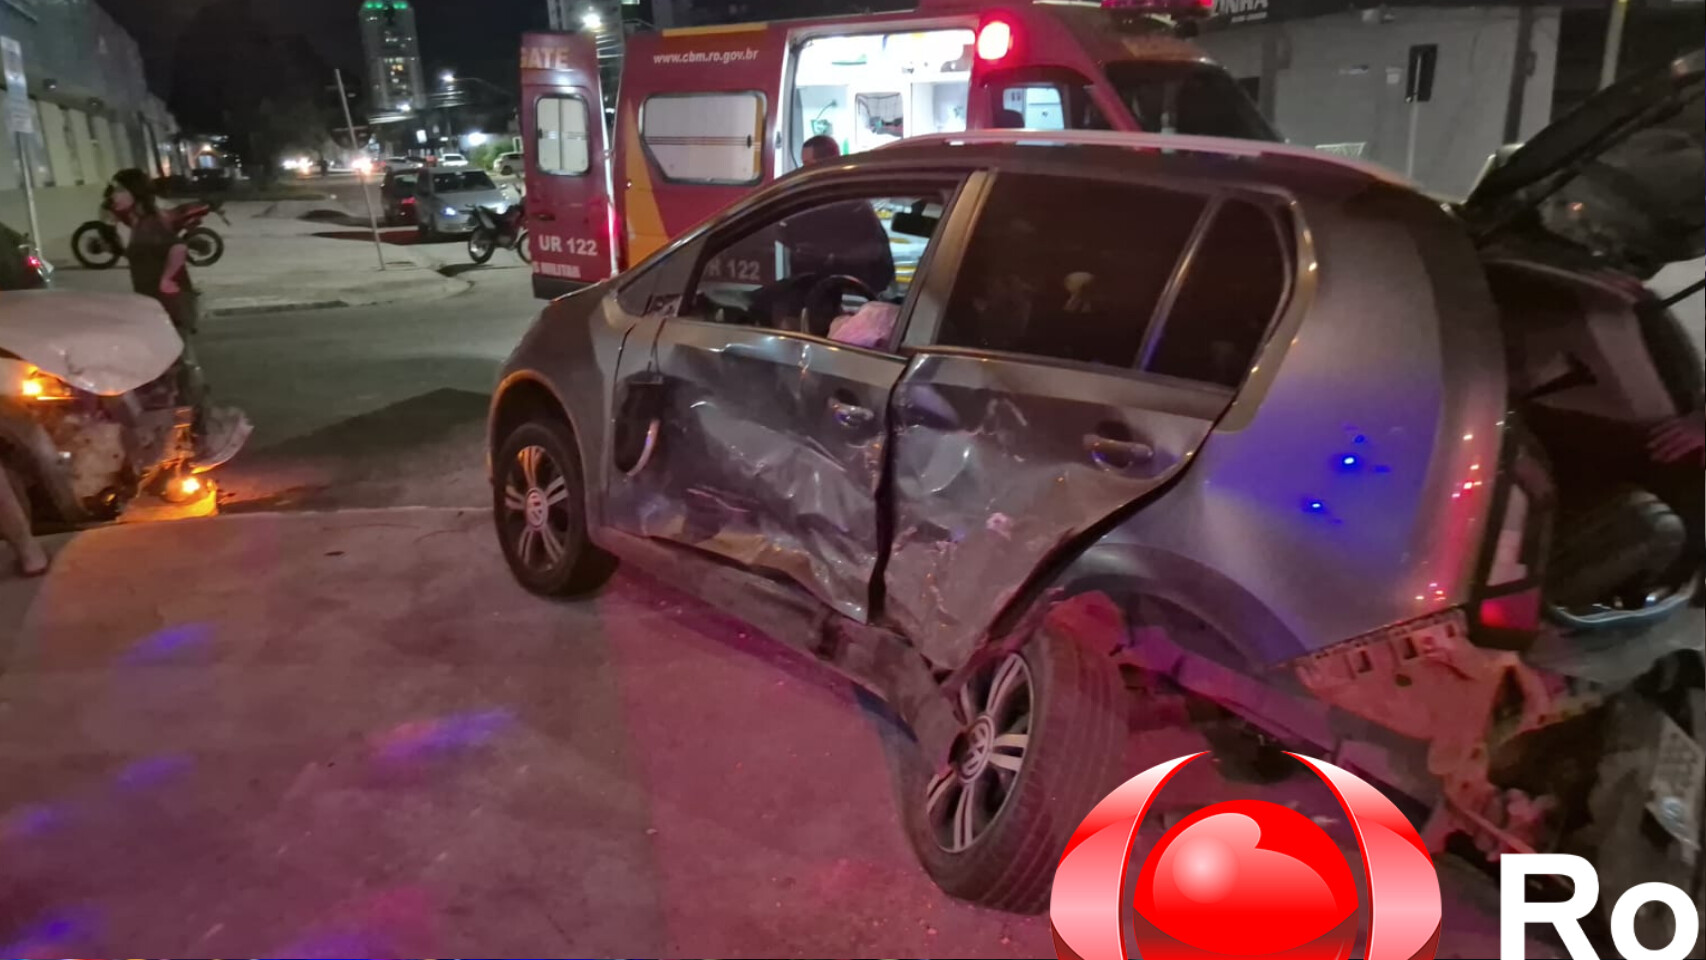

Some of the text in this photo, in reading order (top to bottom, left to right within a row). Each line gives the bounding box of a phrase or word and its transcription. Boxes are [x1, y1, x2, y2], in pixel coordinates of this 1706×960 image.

[653, 47, 759, 64] www.cbm.ro.gov.br
[538, 234, 598, 256] UR 122
[726, 259, 760, 280] 122
